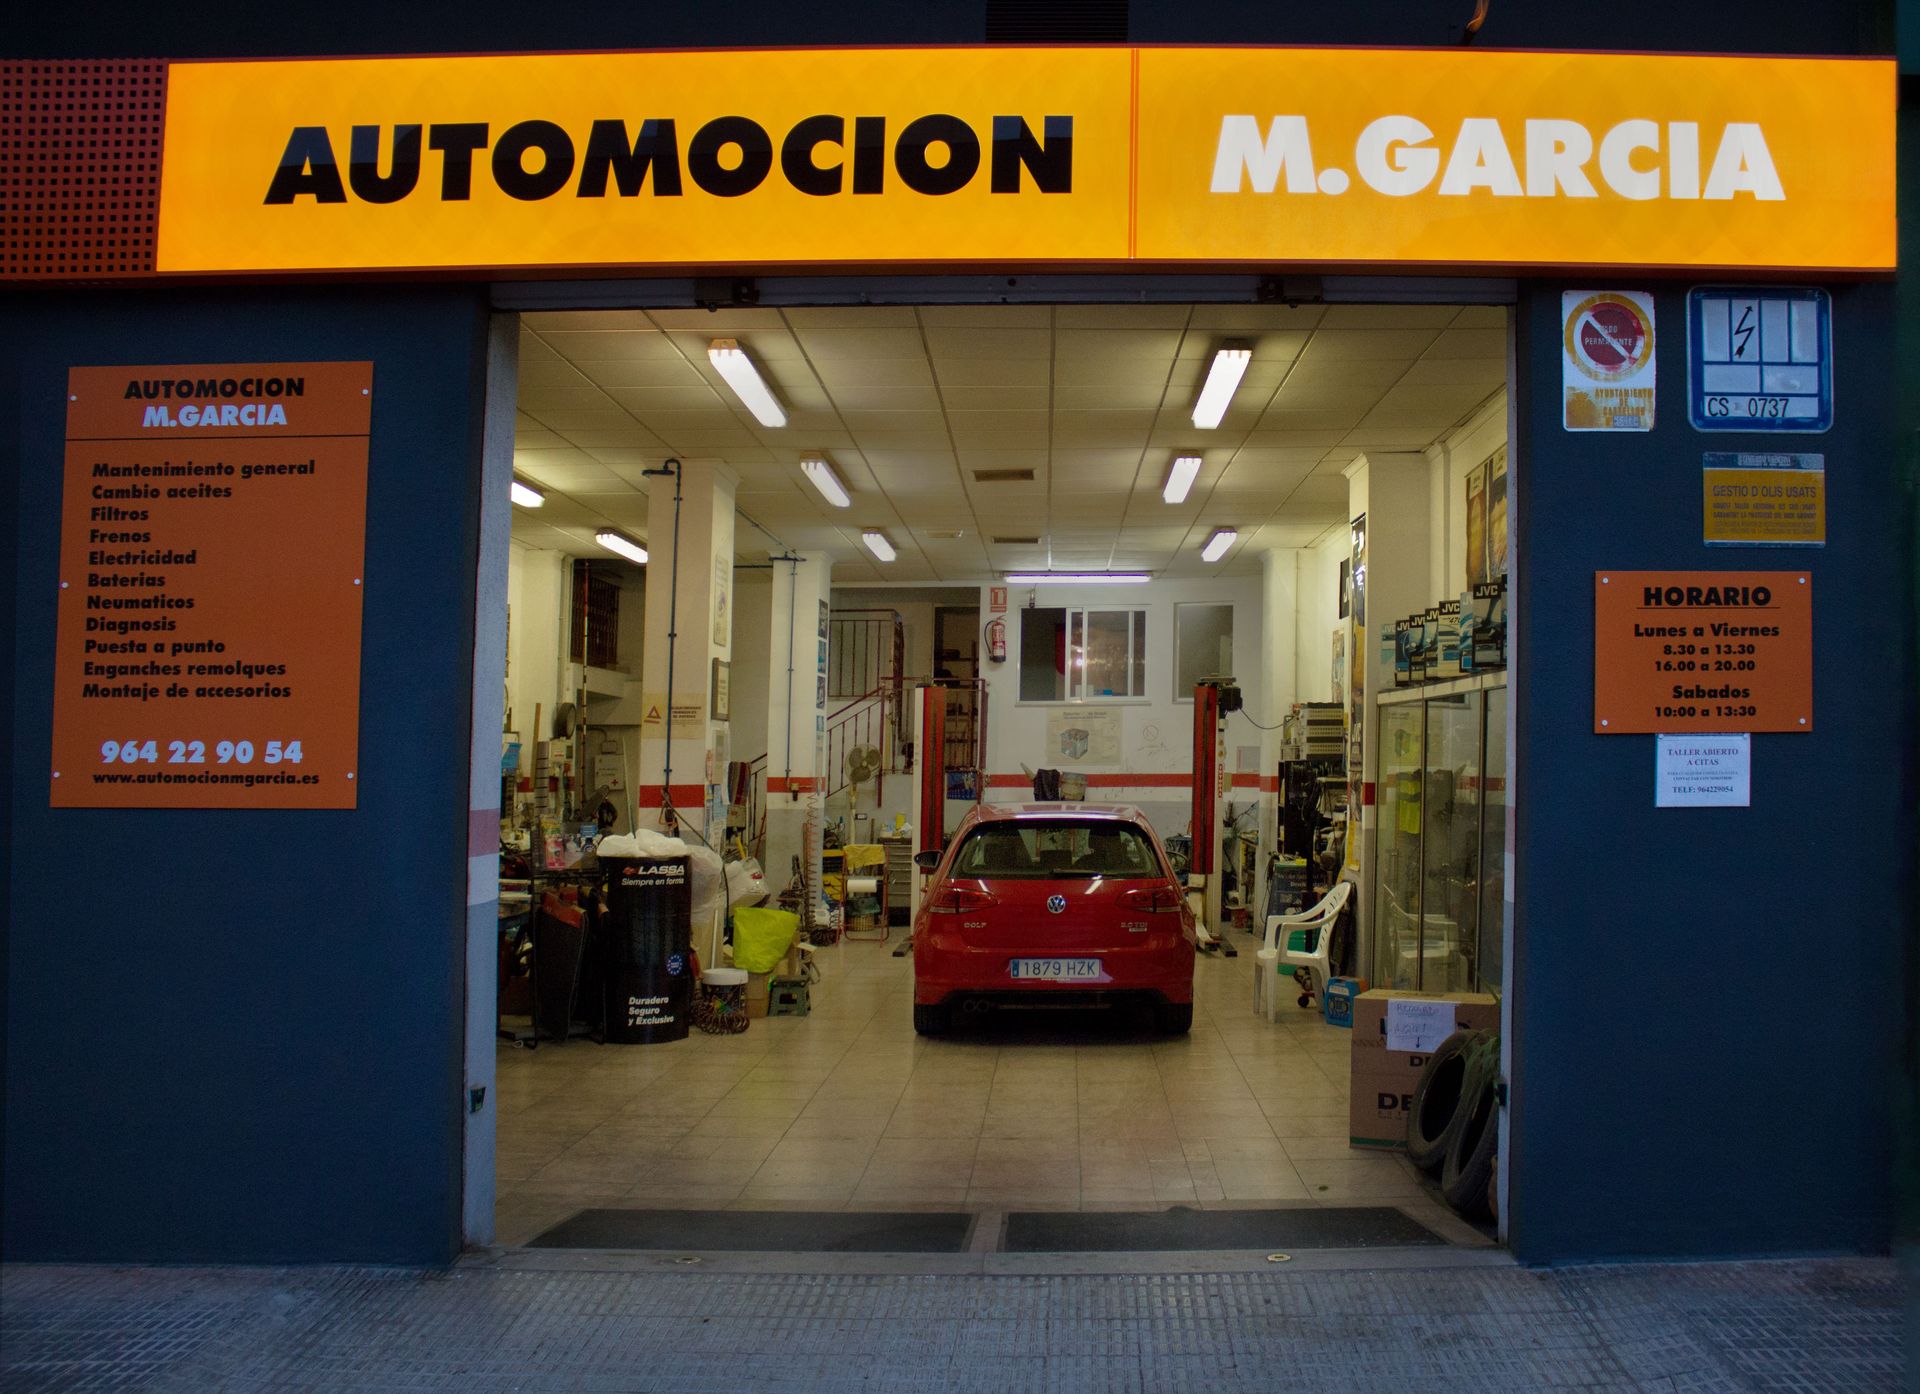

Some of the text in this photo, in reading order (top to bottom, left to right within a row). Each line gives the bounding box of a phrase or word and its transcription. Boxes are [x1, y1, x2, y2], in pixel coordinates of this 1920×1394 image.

[264, 114, 1786, 204] AUTOMOCION M.GARCIA
[1585, 338, 1632, 346] PERMANTE
[124, 378, 305, 399] AUTOMOCION
[1708, 397, 1789, 418] CS 0737
[143, 404, 287, 427] M.GARCIA
[92, 460, 315, 479] Mantenimiento general
[92, 483, 232, 499] Cambio aceites
[1786, 487, 1816, 498] USATS
[91, 506, 149, 522] Filtros
[90, 529, 151, 543] Frenos
[89, 550, 196, 566] Electricidad
[88, 572, 165, 587] Baterias
[1476, 585, 1498, 597] JVC
[1643, 587, 1772, 607] HORARIO
[87, 594, 194, 609] Neumaticos
[1442, 603, 1460, 613] JVC
[85, 616, 176, 635] Diagnosis
[1634, 623, 1780, 637] Lunes a Viernes
[85, 639, 225, 656] Puesta a punto
[1663, 644, 1755, 655] 8.30 a 13.30
[84, 660, 286, 679] Enganches remolques
[1655, 661, 1755, 671] 16.00 a 20.00
[83, 683, 291, 701] Montaje de accesorios
[1672, 684, 1750, 699] Sabados
[1655, 706, 1756, 717] 10:00 a 13:30
[101, 741, 302, 763] 964 22 90 54
[93, 771, 319, 787] www.automocionmgarcia.es
[638, 865, 684, 876] LASSA
[622, 878, 653, 887] Siempre
[1025, 961, 1096, 976] 1879 HZK
[628, 996, 669, 1005] Duradero
[628, 1006, 660, 1016] Seguro
[628, 1015, 674, 1026] y Exclusivo
